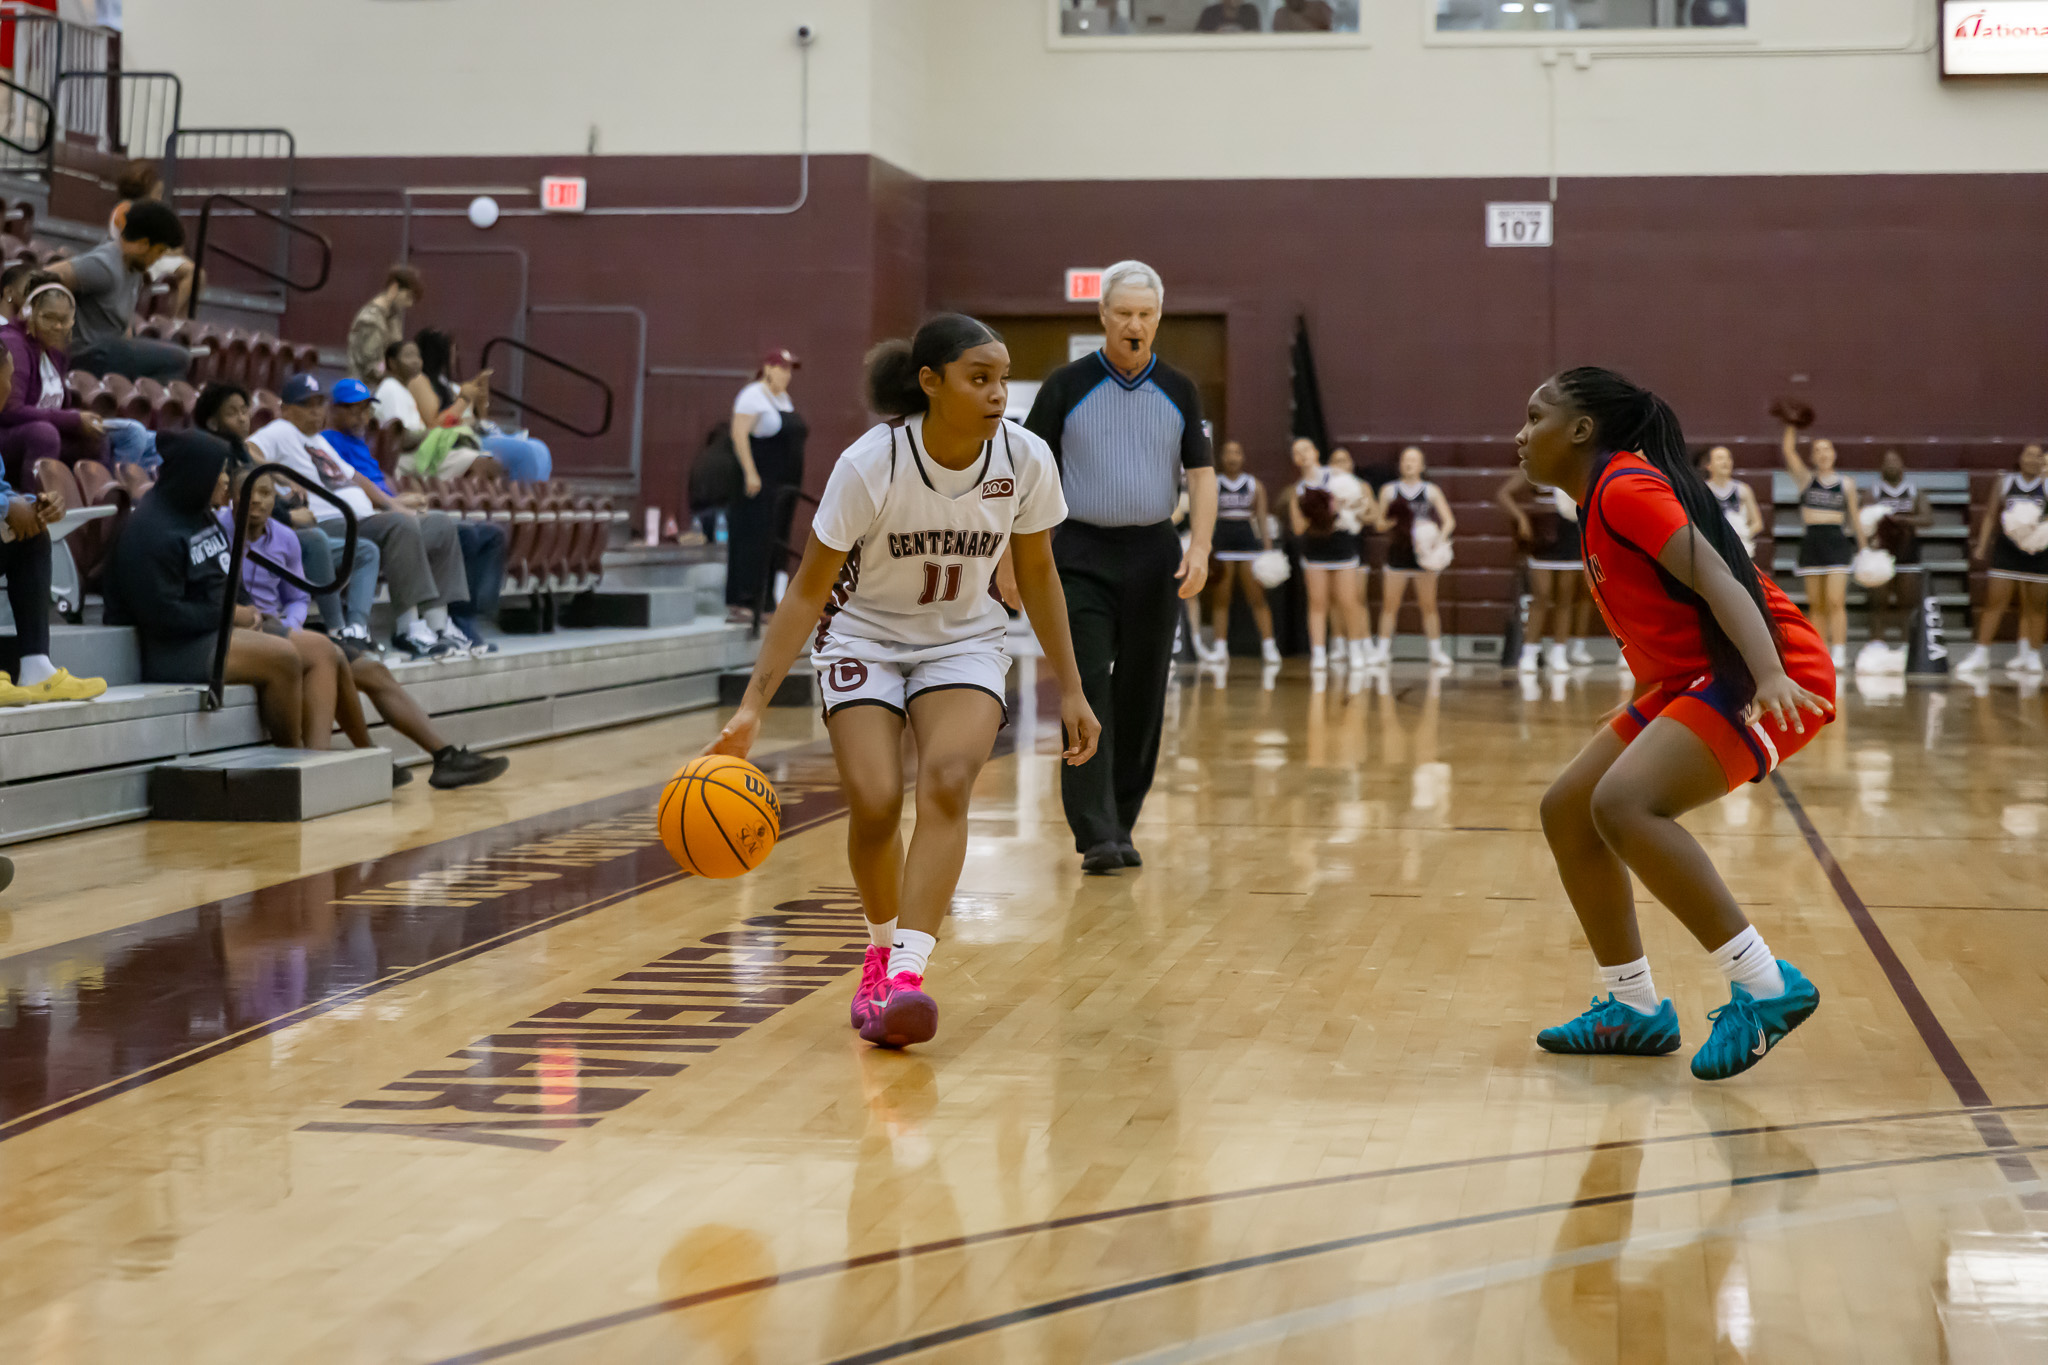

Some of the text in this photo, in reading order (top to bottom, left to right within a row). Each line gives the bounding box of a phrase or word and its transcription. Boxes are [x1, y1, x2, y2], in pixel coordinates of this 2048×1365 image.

[1499, 221, 1541, 242] 107
[982, 480, 1012, 496] 200
[887, 529, 1004, 559] CENTENARY
[917, 561, 963, 606] 11
